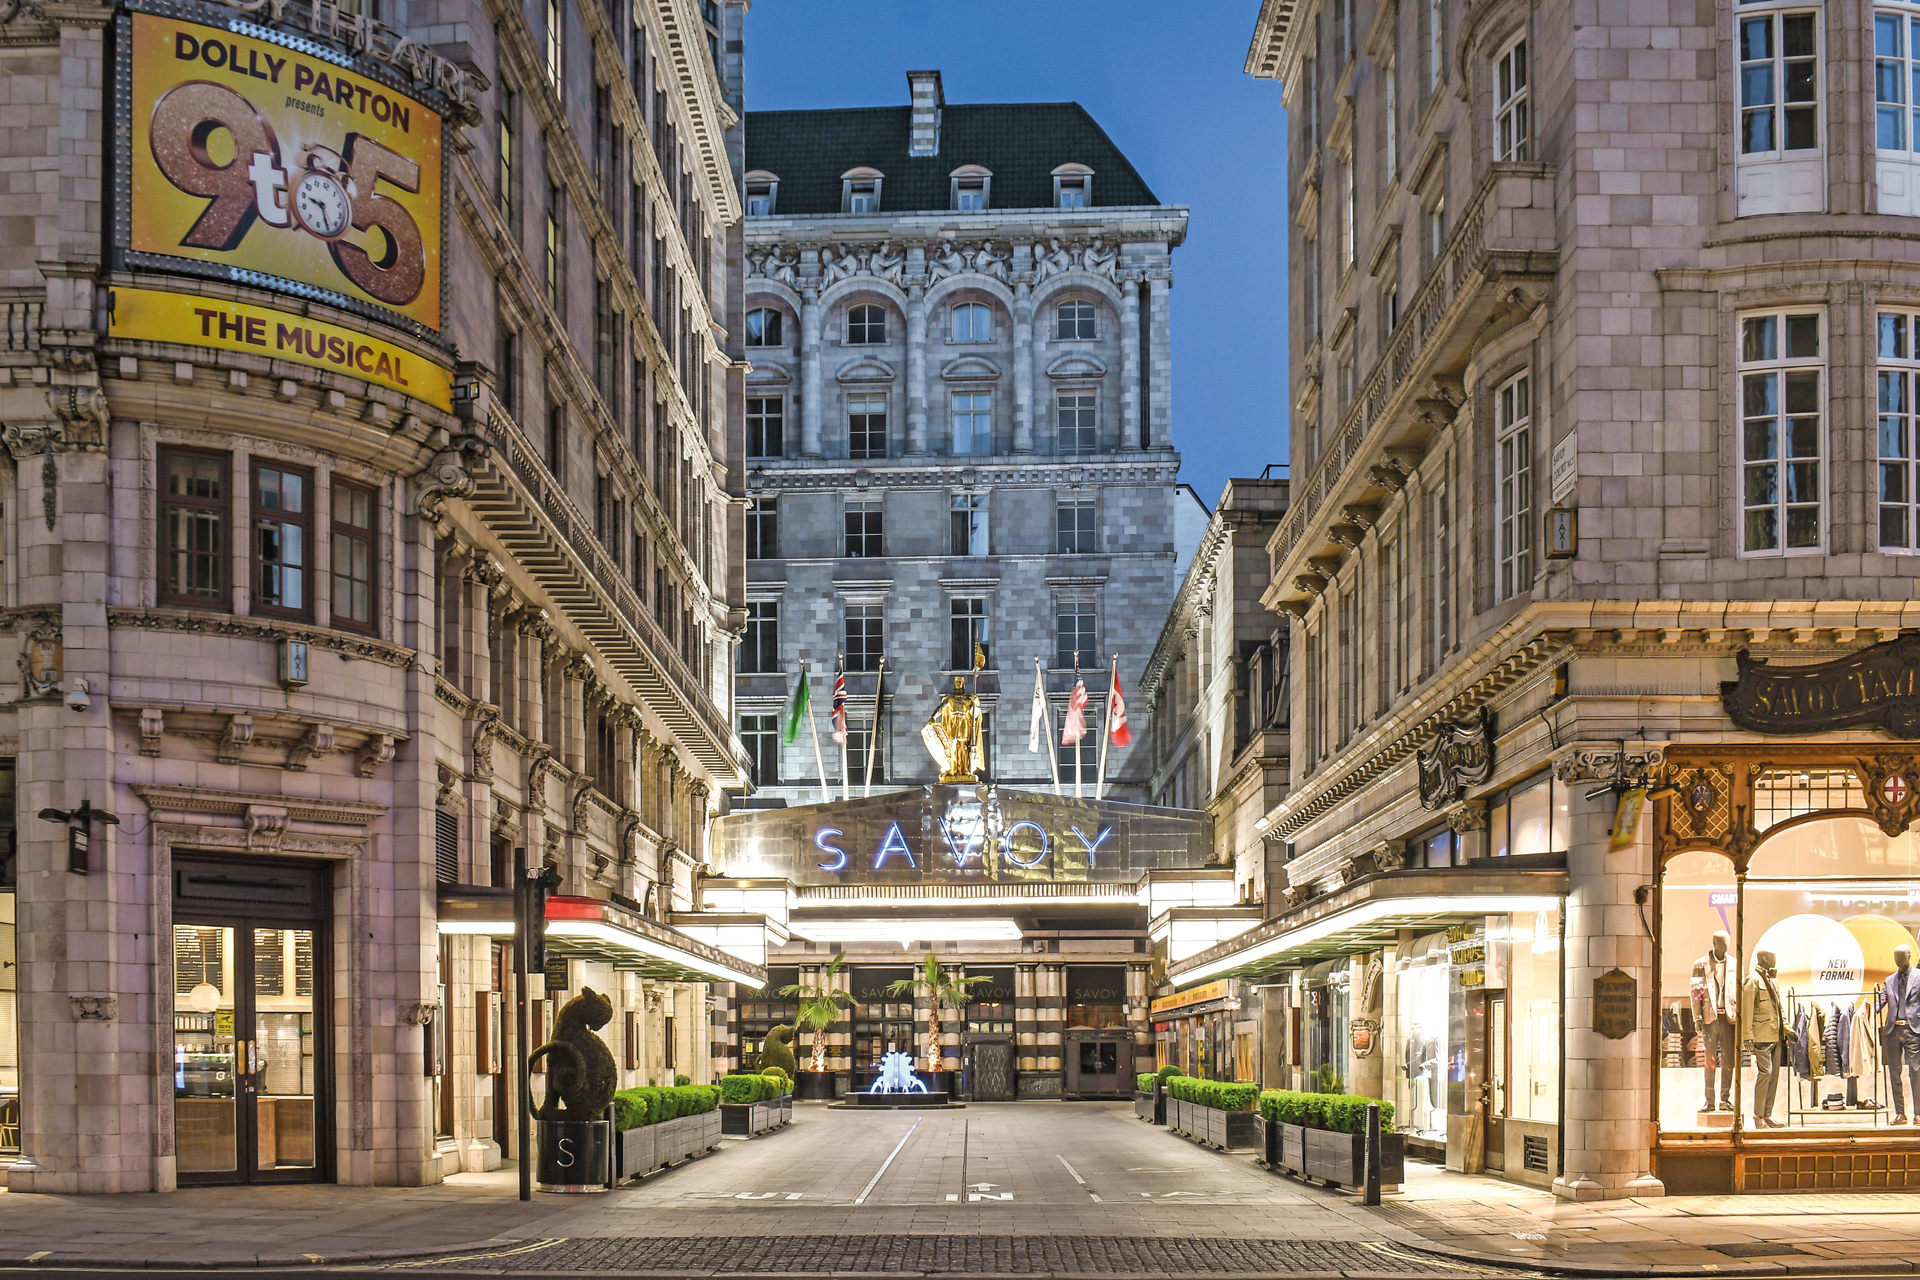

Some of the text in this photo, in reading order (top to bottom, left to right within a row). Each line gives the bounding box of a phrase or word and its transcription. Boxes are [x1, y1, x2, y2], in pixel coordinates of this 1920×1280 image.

[175, 31, 410, 134] DOLLY PARTON
[285, 95, 325, 118] presents
[194, 307, 409, 387] THE MUSICAL
[1558, 513, 1566, 550] TAXI
[294, 644, 302, 679] TAXI
[1749, 679, 1840, 716] SAVOY
[814, 816, 1113, 871] SAVOY
[1827, 958, 1849, 969] NEW
[1819, 970, 1855, 981] FORMAL
[747, 988, 785, 999] SAVO
[861, 988, 896, 998] SAVO
[969, 987, 1012, 998] SAVOY
[1075, 988, 1118, 999] SAVOY
[1597, 982, 1633, 992] SAVOY
[556, 1137, 575, 1168] S
[679, 1190, 816, 1200] OUT
[945, 1192, 1014, 1202] IN
